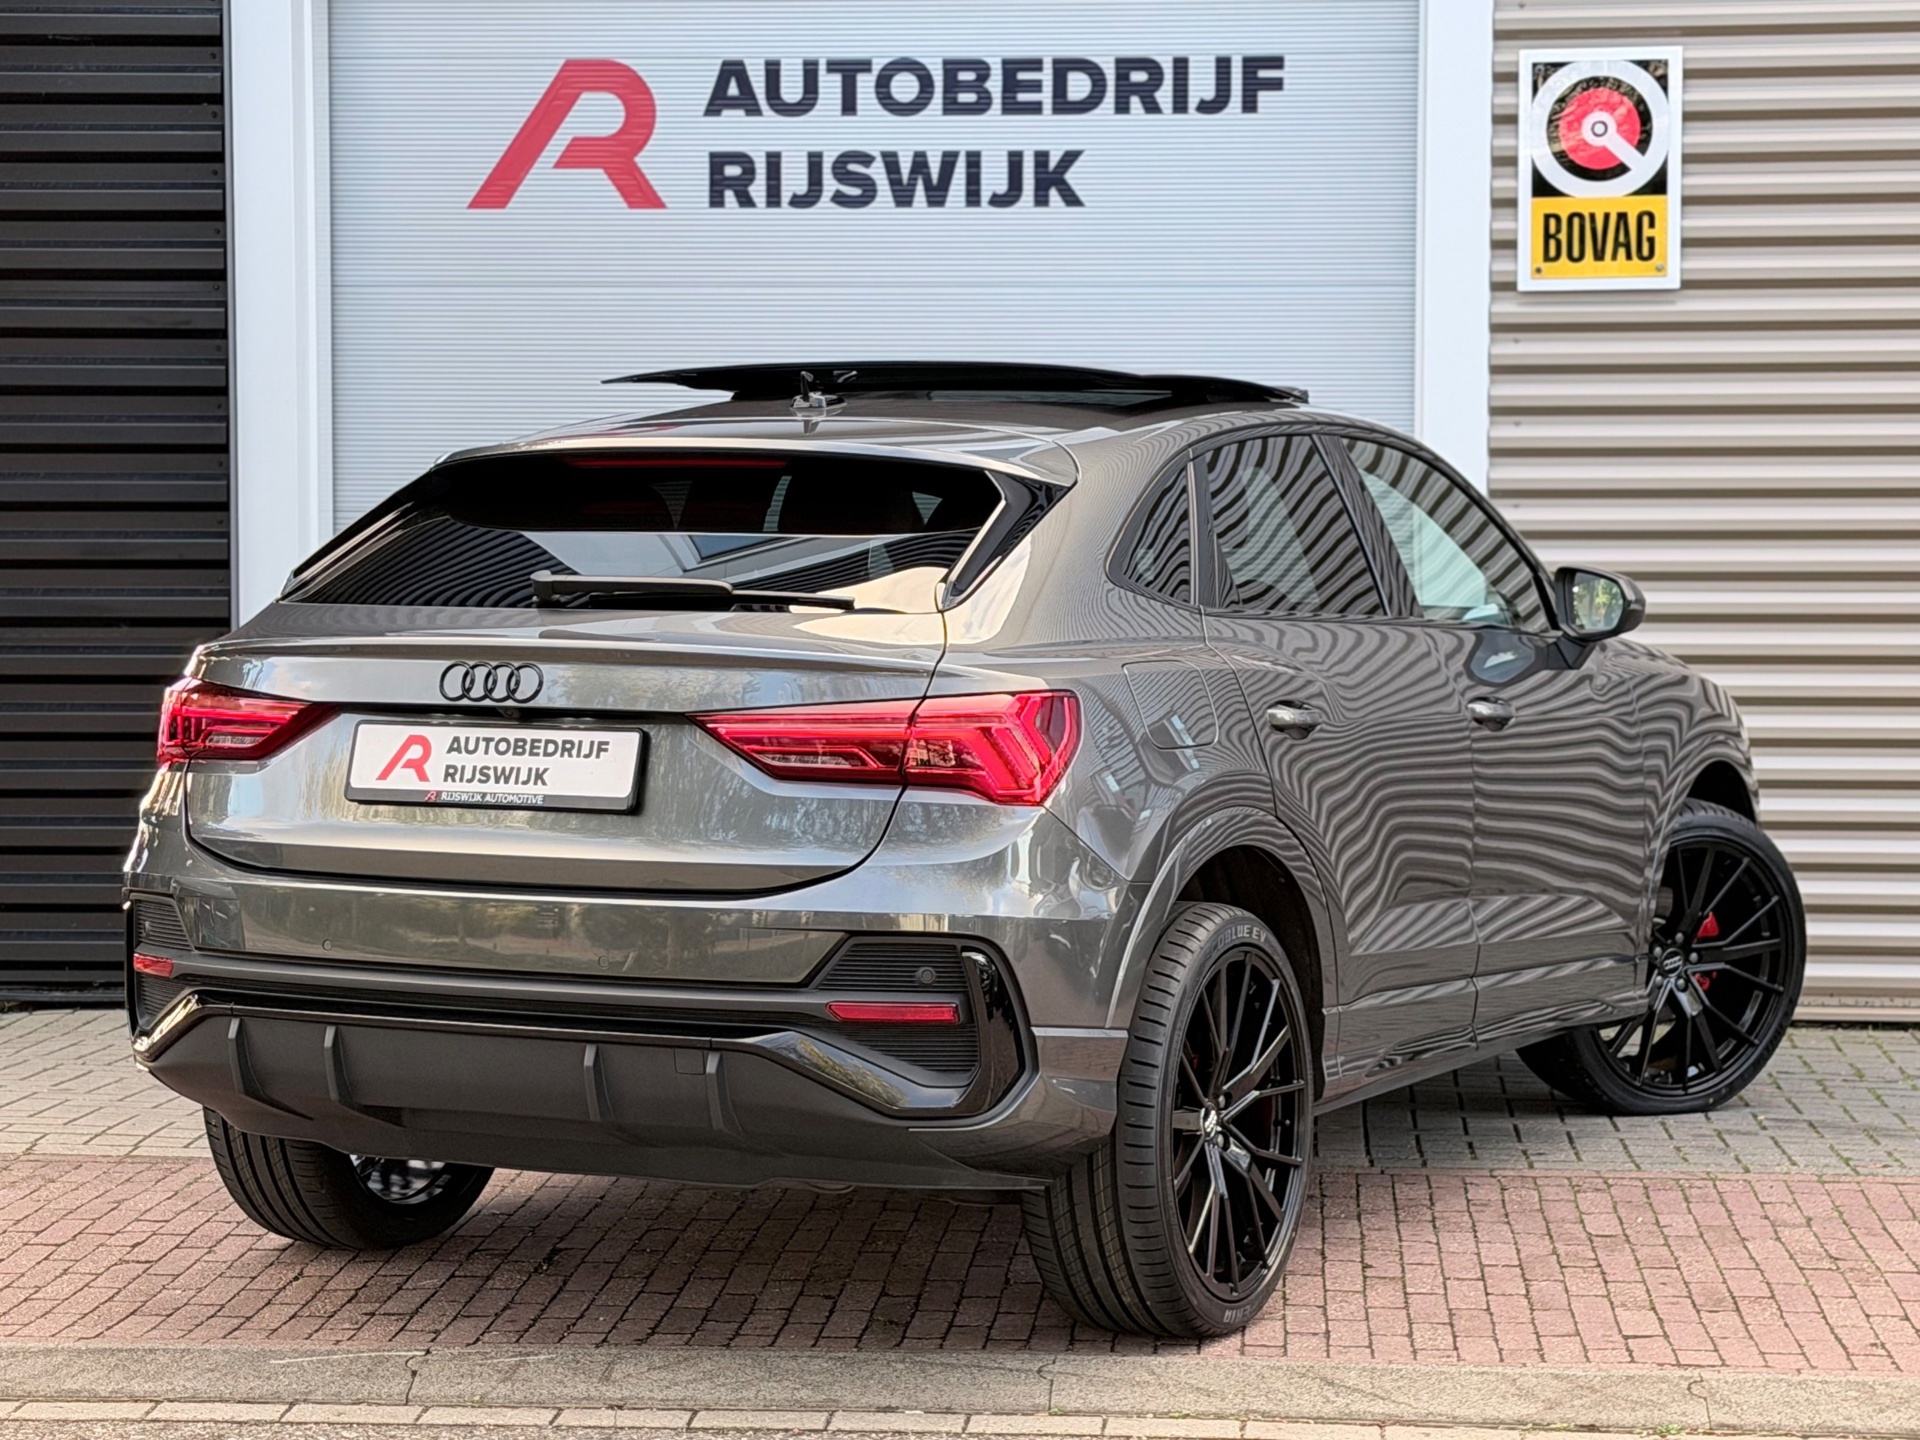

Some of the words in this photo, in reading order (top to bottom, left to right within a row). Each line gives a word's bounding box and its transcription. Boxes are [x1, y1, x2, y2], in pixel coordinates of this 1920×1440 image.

[703, 54, 1285, 117] AUTOBEDRIJF
[708, 150, 1085, 209] RIJSWIJK
[1543, 210, 1656, 263] BOVAG
[446, 735, 610, 759] AUTOBEDRIJF
[443, 764, 550, 787] RIJSWIJK
[441, 791, 483, 803] RIJSWIJK
[484, 793, 544, 805] AUTOMOTIVE
